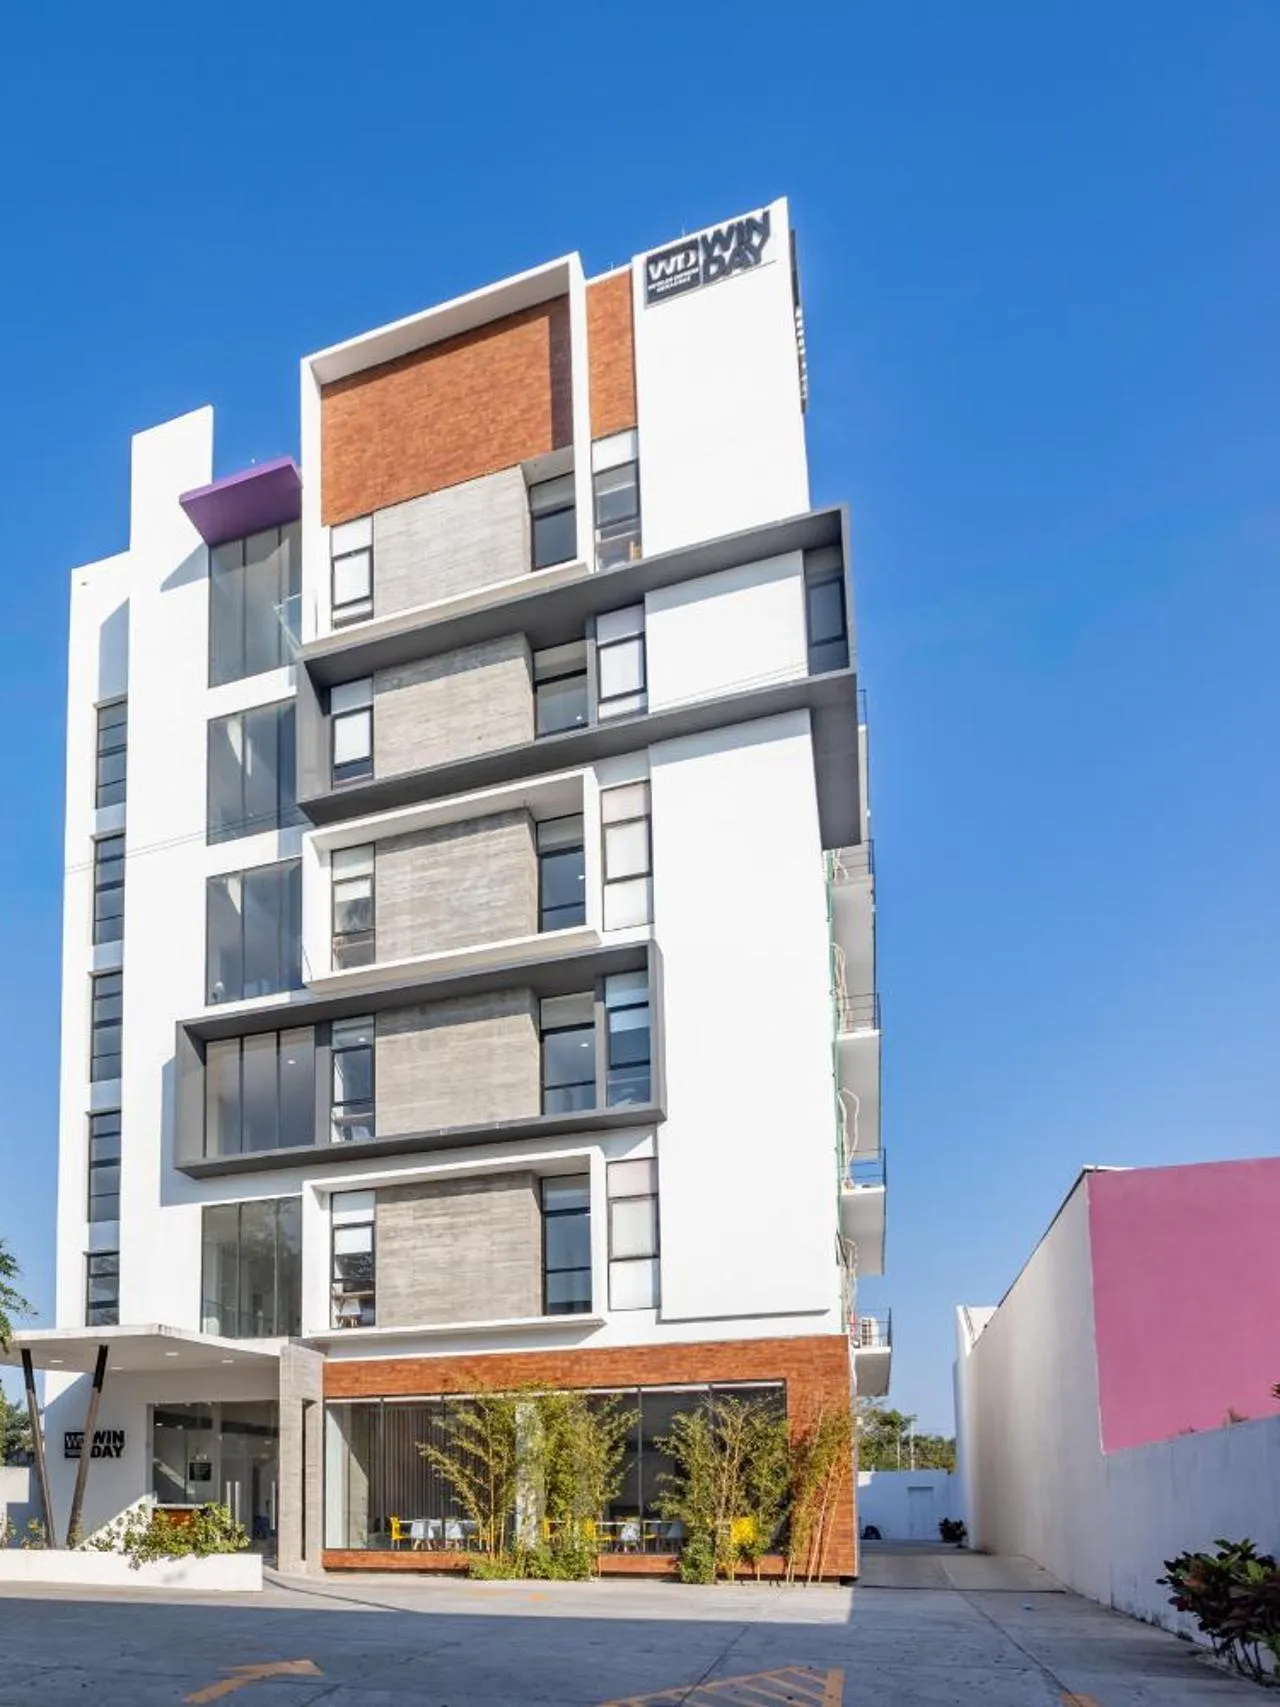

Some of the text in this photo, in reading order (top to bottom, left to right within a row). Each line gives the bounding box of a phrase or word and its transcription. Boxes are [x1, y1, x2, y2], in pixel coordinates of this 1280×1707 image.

[701, 210, 770, 256] WIN
[702, 235, 769, 284] DAY
[90, 1445, 124, 1458] DAY
[93, 1430, 125, 1445] WIN
